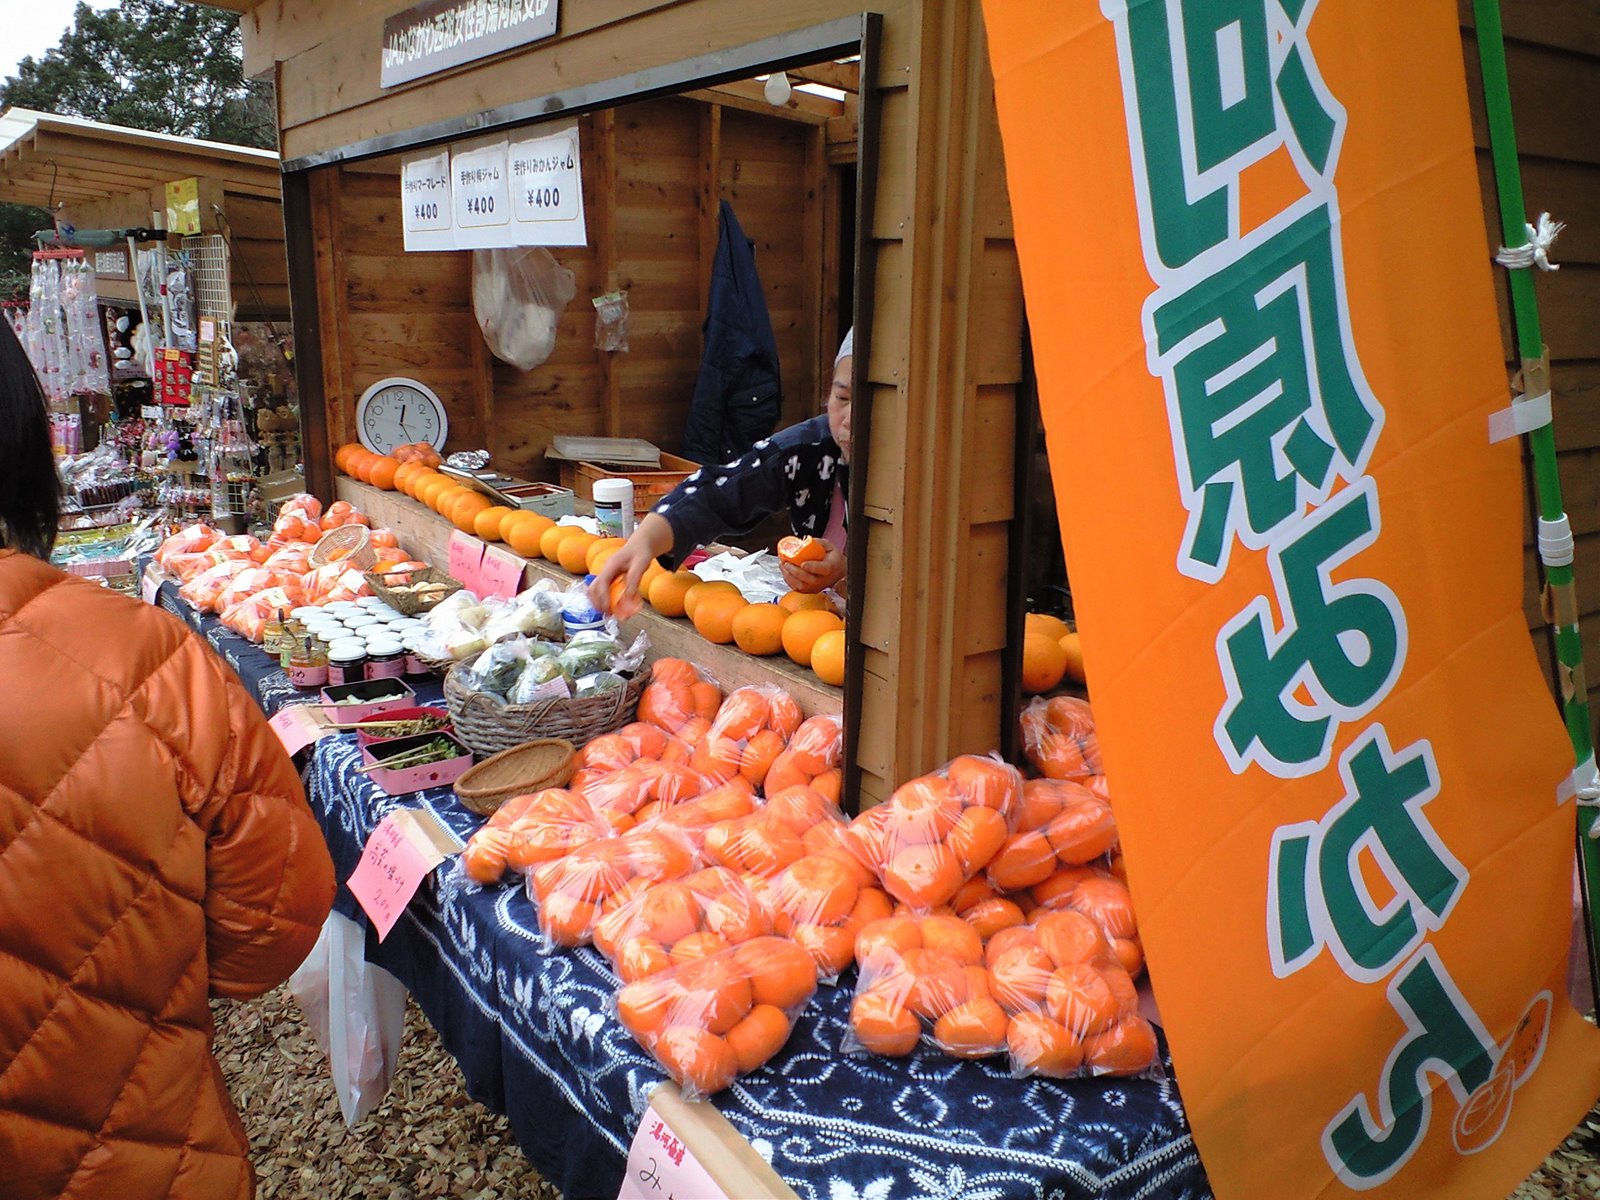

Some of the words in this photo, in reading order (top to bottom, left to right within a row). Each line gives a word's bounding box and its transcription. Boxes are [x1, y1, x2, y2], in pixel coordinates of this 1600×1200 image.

[527, 187, 560, 208] ¥400
[467, 195, 495, 215] ¥400
[414, 203, 438, 220] ¥400
[381, 395, 390, 405] 11
[394, 391, 404, 401] 12
[371, 405, 383, 416] 10
[418, 404, 426, 414] 2
[368, 419, 376, 430] 9
[425, 419, 432, 429] 3
[374, 433, 382, 444] 8
